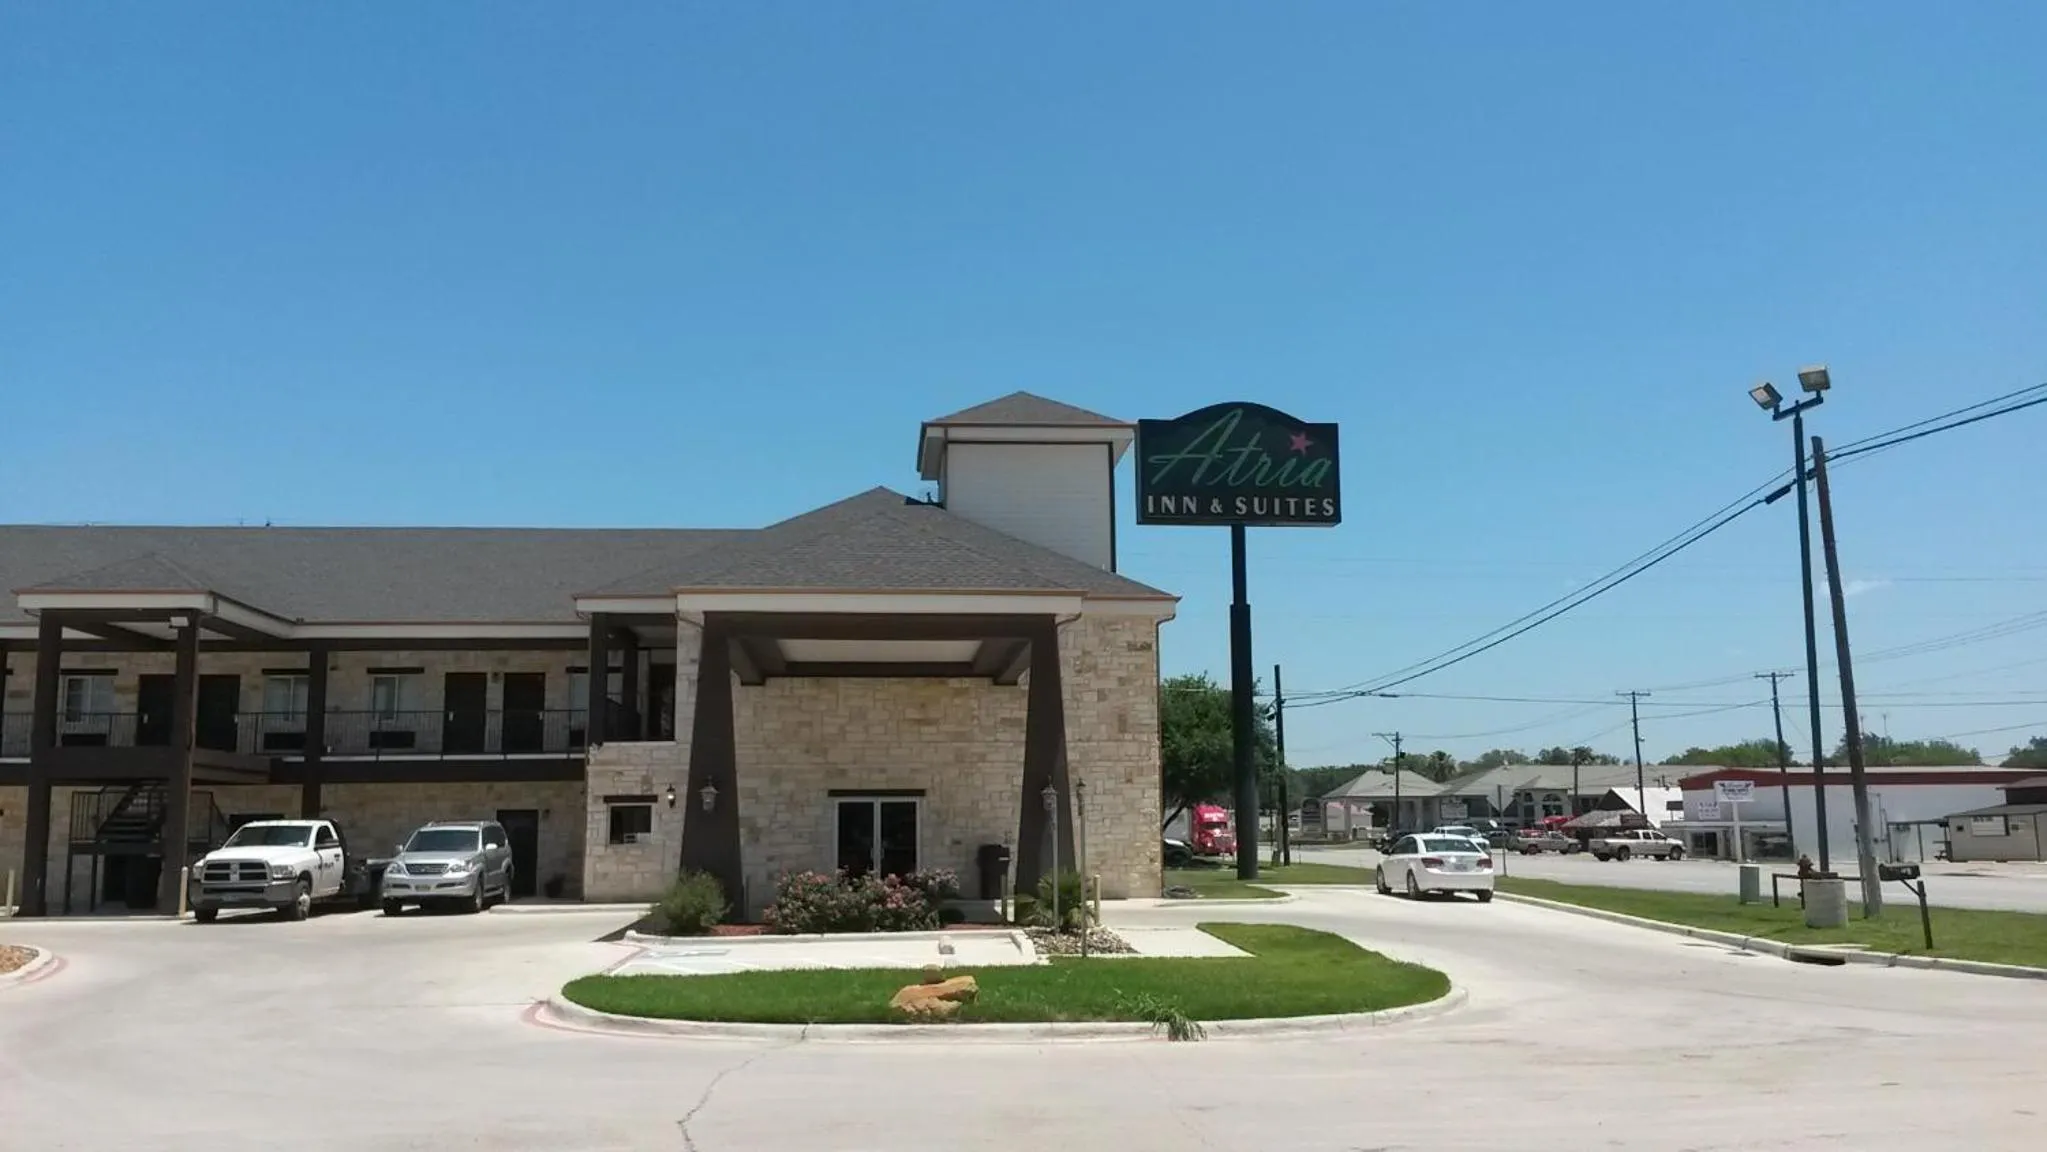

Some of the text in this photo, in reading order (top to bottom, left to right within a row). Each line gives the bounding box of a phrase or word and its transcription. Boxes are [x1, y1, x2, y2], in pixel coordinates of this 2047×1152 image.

[1148, 408, 1332, 488] Atria
[1148, 495, 1335, 516] INN & SUITES
